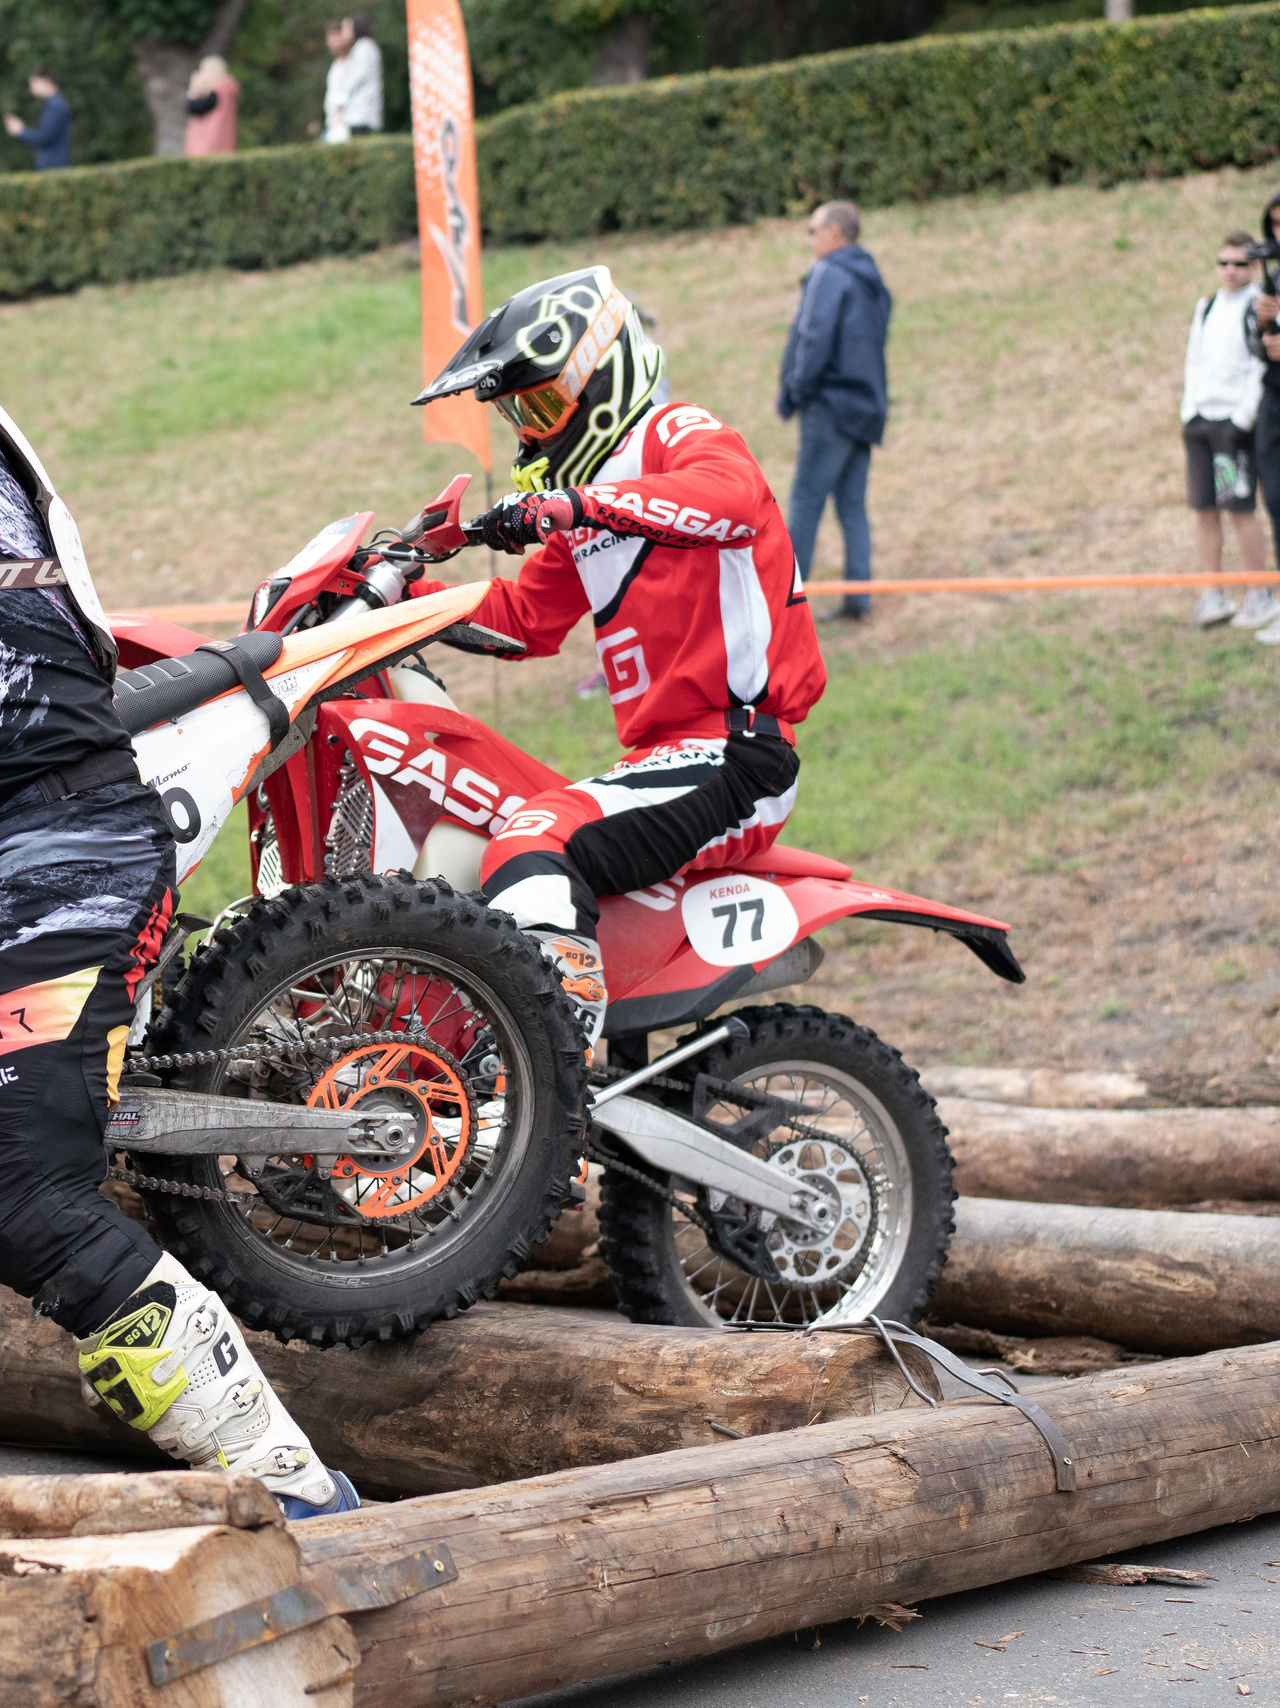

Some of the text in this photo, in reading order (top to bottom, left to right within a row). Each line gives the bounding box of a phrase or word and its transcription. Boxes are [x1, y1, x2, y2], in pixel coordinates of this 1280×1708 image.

[596, 505, 677, 541] FACTORY
[676, 531, 715, 547] RAC
[582, 533, 638, 558] RACIN
[709, 883, 751, 900] KENDA
[711, 897, 765, 949] 77
[111, 1112, 140, 1120] HAL
